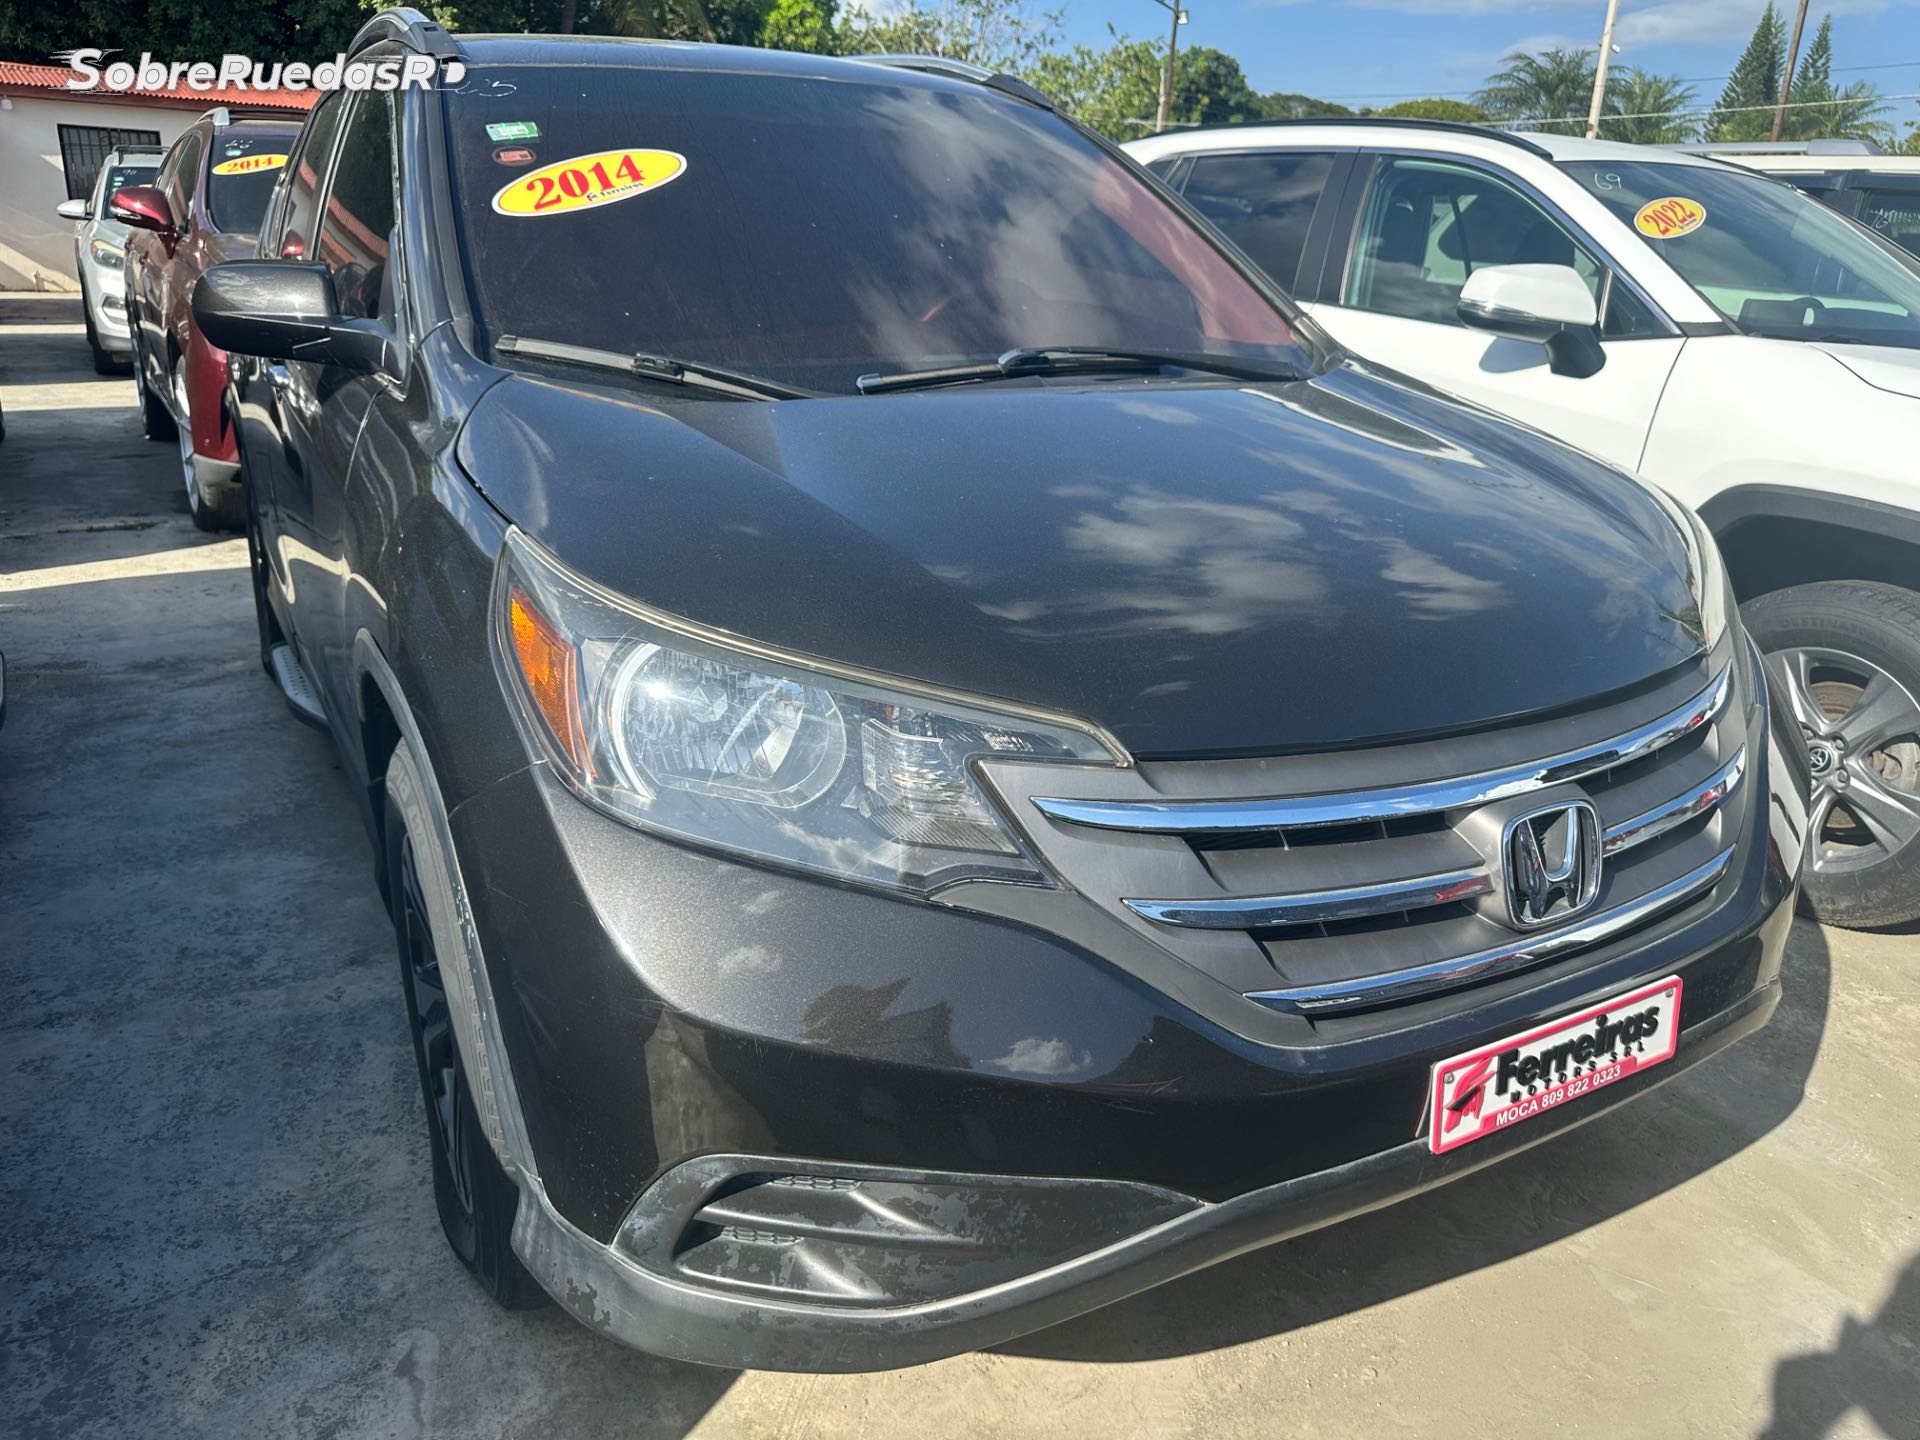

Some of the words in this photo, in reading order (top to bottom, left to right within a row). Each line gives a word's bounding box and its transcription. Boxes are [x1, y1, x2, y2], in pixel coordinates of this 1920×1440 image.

[227, 157, 273, 173] 2014
[526, 155, 645, 211] 2014
[1594, 172, 1622, 190] 69
[1643, 200, 1696, 235] 2022
[1495, 1006, 1660, 1096] Ferreiras
[1496, 1101, 1538, 1126] MOCA
[1541, 1088, 1564, 1108] 809
[1567, 1077, 1589, 1097] 822
[1593, 1064, 1621, 1086] 0323
[1510, 1060, 1597, 1103] MOTORS
